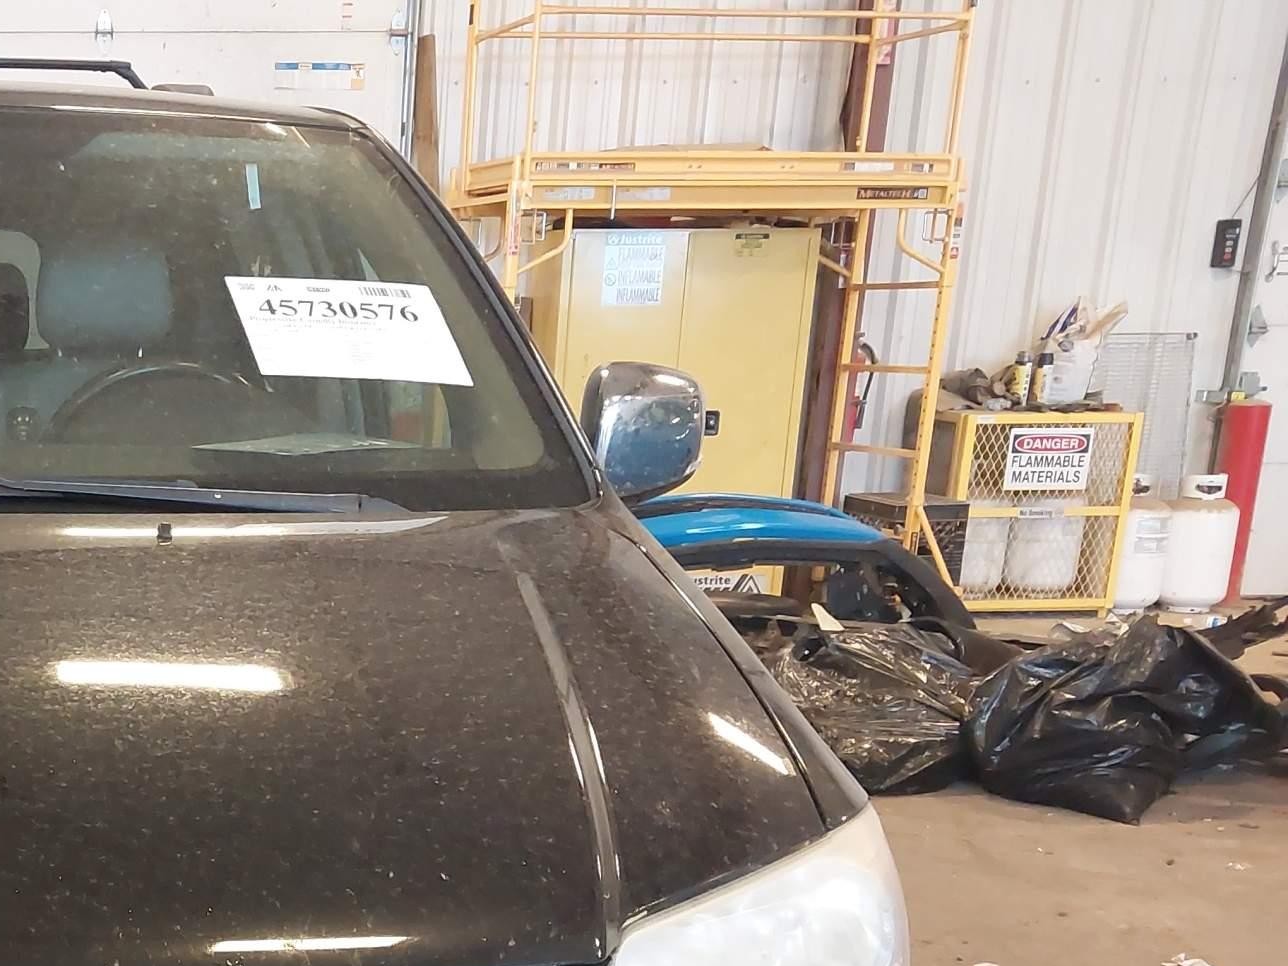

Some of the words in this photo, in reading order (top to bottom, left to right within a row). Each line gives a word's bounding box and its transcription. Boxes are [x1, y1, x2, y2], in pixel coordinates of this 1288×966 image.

[259, 298, 419, 323] 45730576
[1023, 438, 1079, 449] DANGER
[1011, 455, 1086, 468] FLAMMABLE
[1011, 470, 1081, 483] MATERIALS
